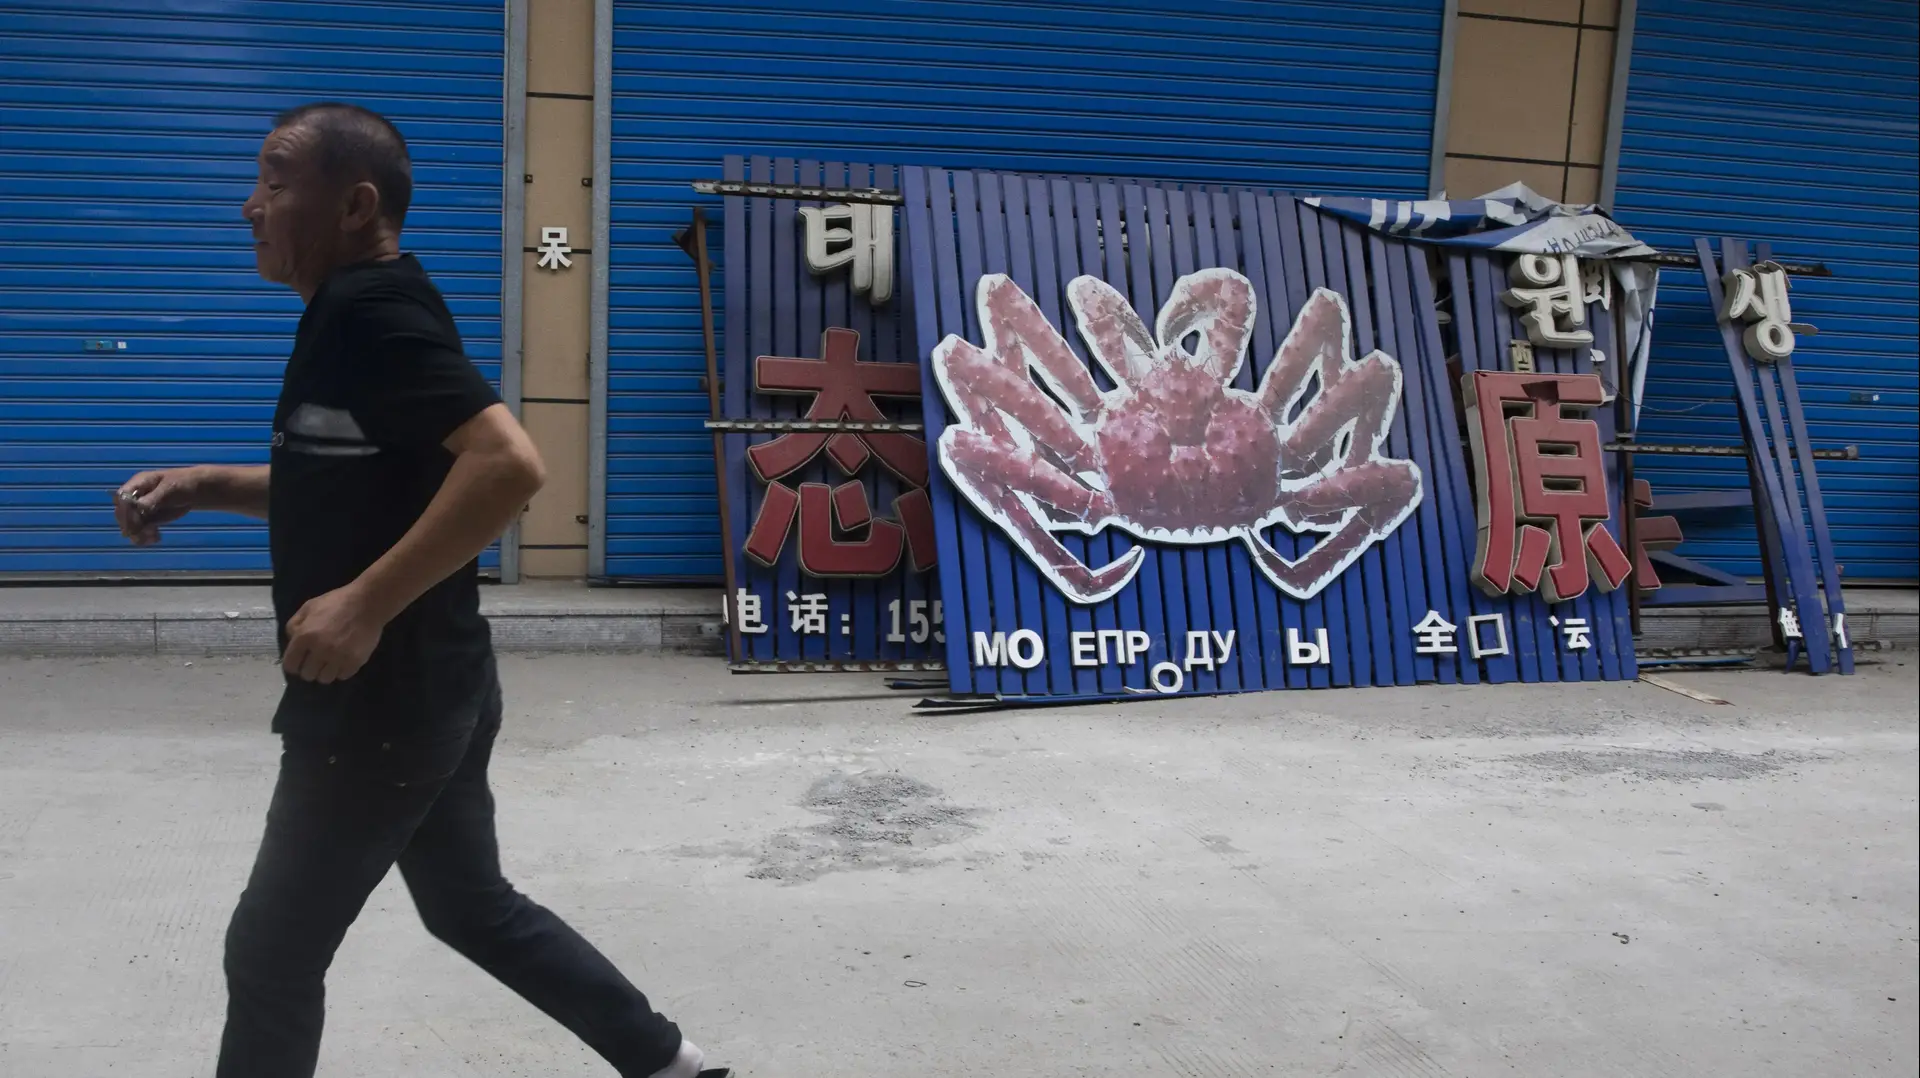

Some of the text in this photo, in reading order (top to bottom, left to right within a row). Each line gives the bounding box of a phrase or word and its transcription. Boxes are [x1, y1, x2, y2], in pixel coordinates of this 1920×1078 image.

[798, 202, 894, 303] 태
[746, 326, 938, 577] 态
[1468, 370, 1633, 601] 原
